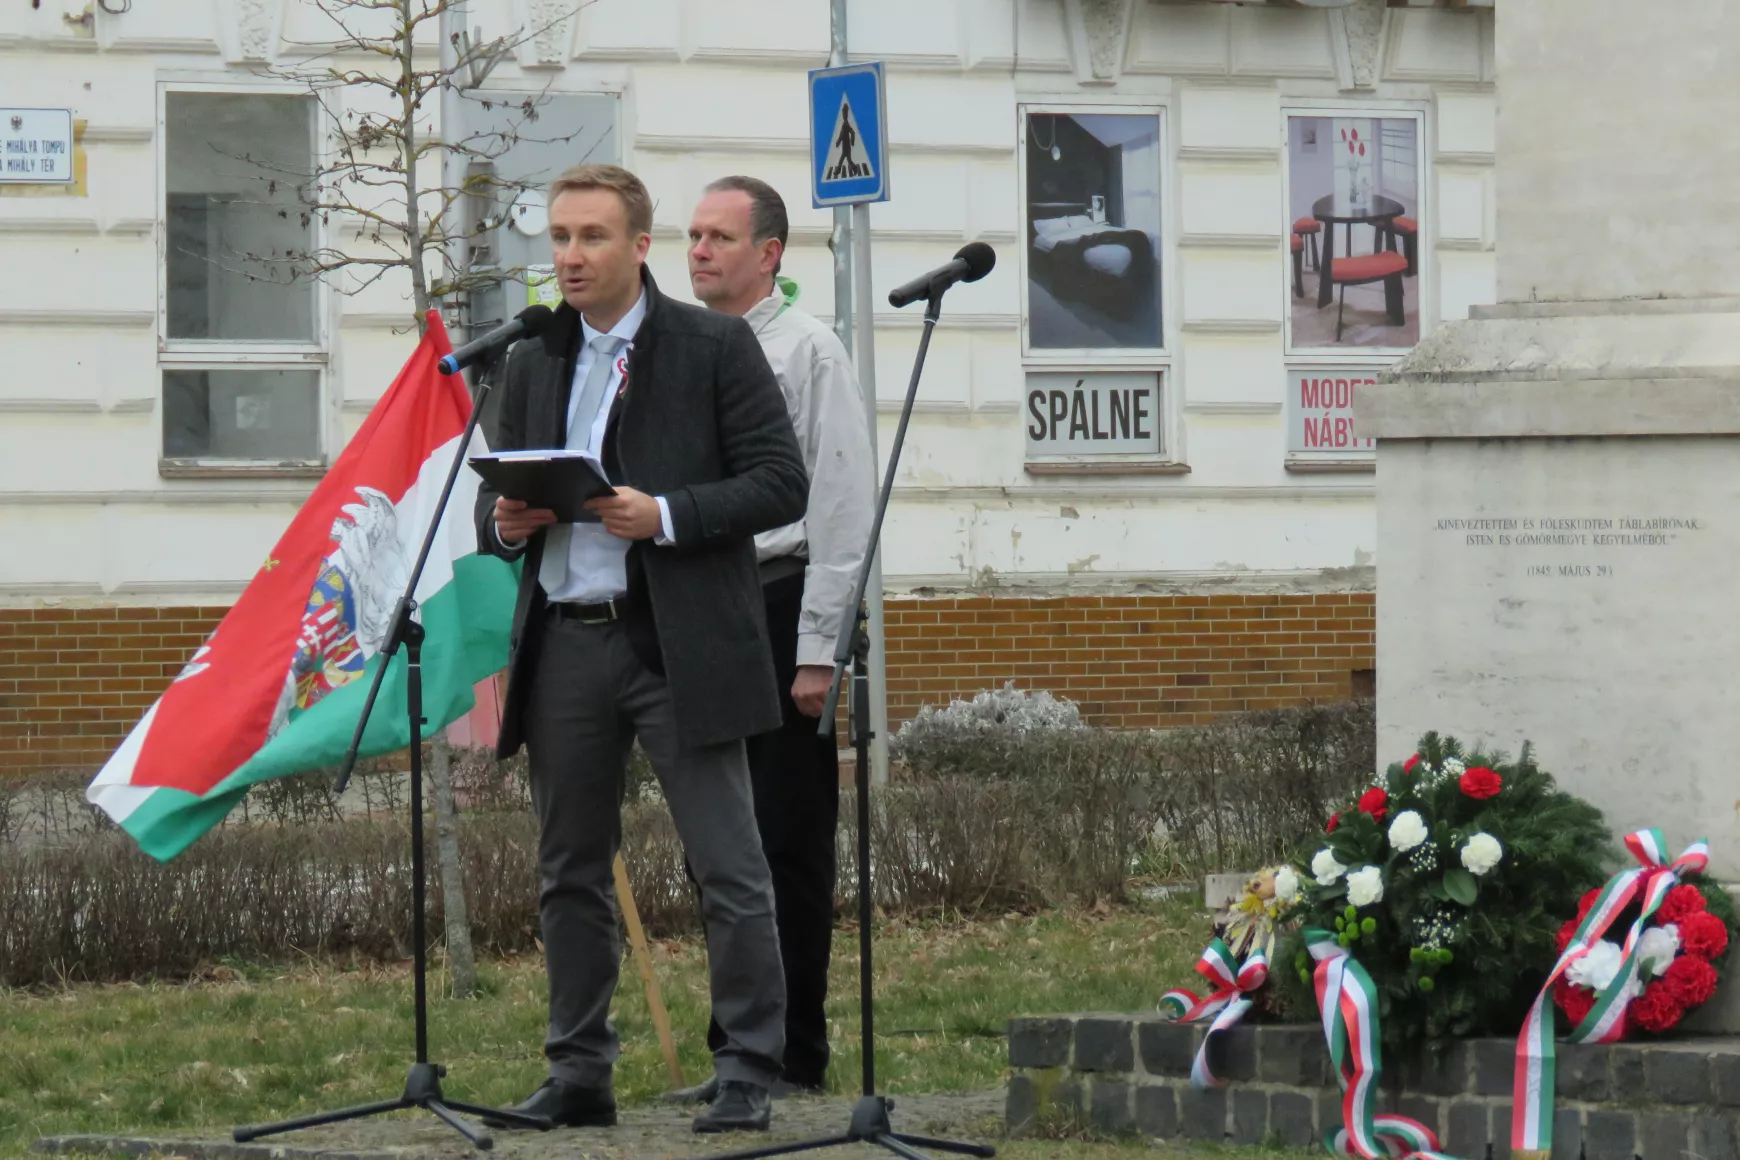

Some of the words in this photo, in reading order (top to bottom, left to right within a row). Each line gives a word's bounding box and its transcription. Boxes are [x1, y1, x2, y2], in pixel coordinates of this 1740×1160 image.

[6, 137, 38, 154] MIHÁLYA
[41, 139, 66, 154] TOMPU
[7, 156, 36, 173] MIHÁLY
[40, 156, 55, 173] TÉR
[1028, 379, 1151, 441] SPÁLNE
[1523, 516, 1535, 530] ÉS
[1466, 534, 1493, 546] ISTEN
[1499, 533, 1511, 546] ÉS
[1558, 563, 1591, 577] MÁJUS
